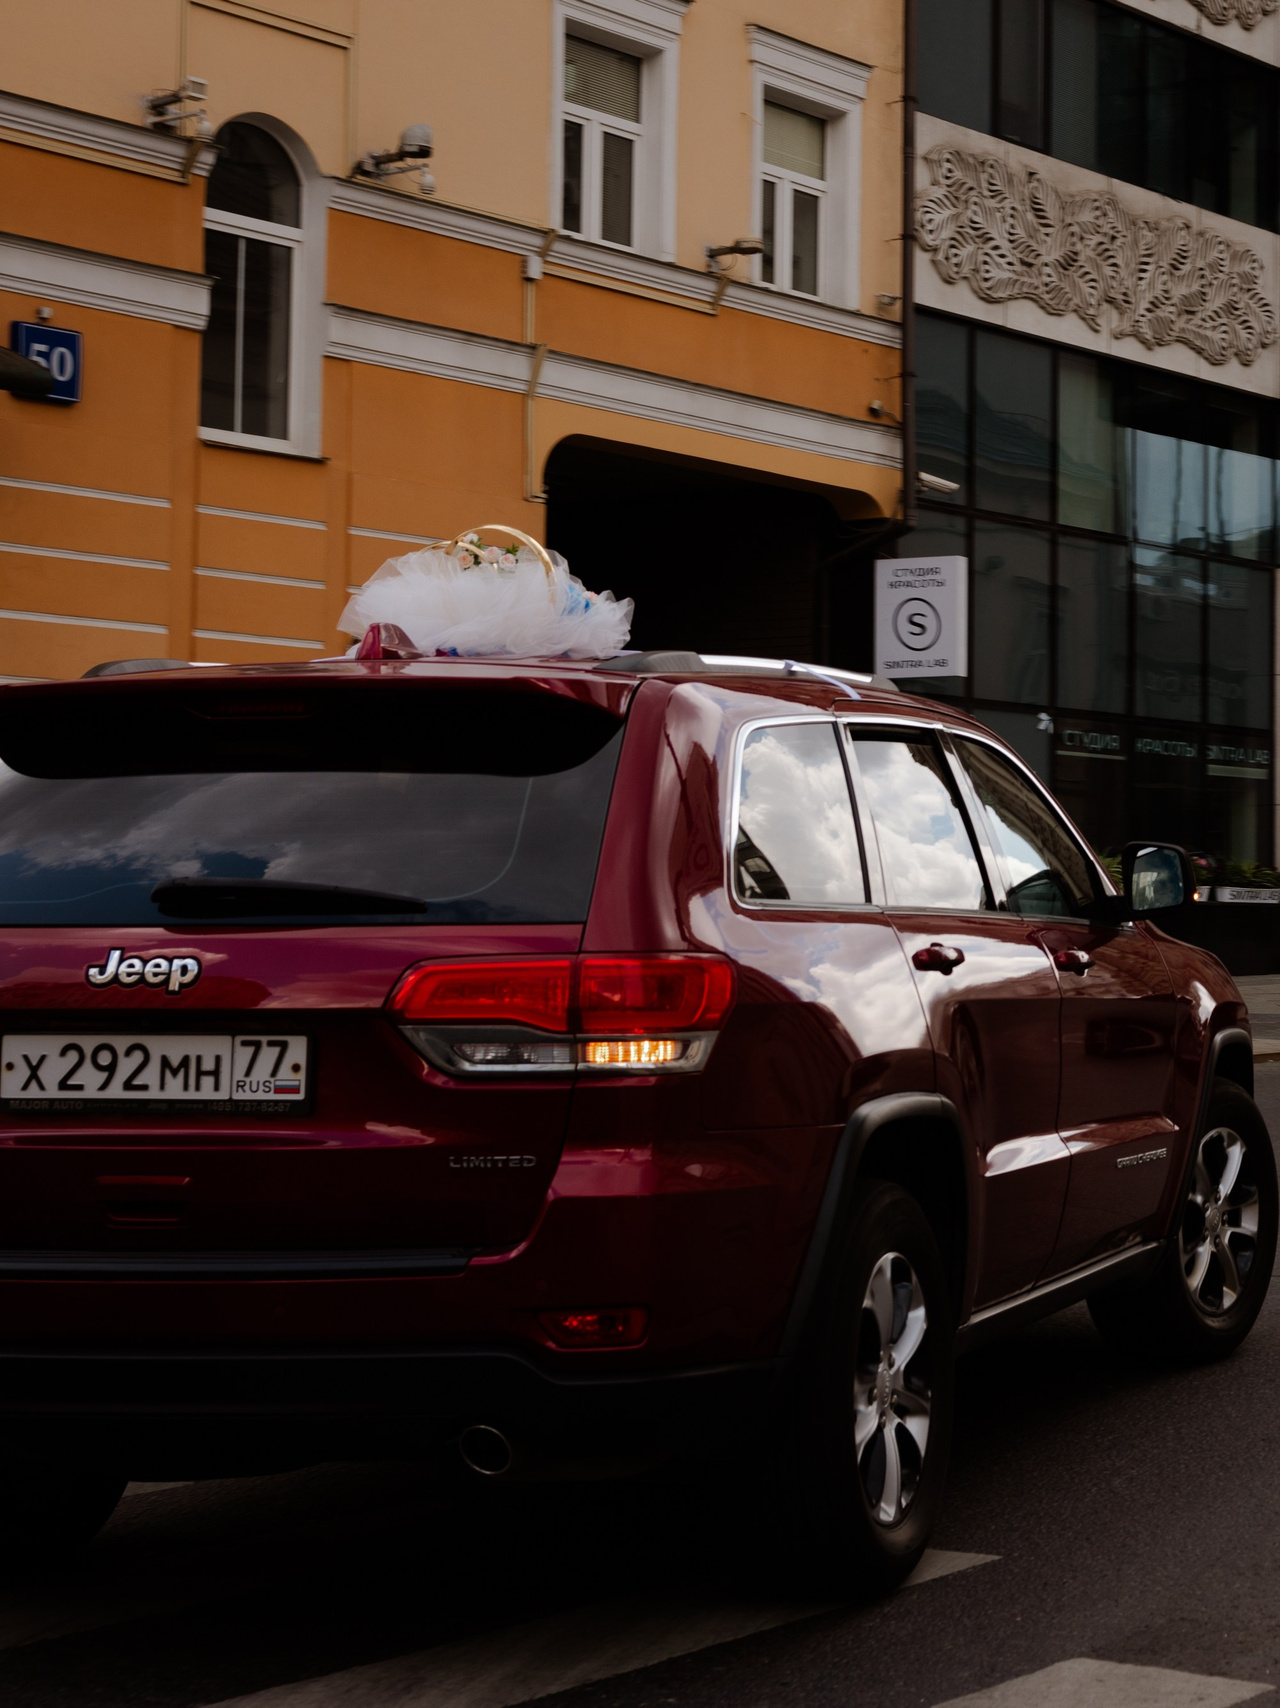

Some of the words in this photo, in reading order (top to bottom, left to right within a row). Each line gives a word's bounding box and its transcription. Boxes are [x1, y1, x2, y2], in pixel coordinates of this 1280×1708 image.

[28, 342, 75, 382] 50
[86, 948, 201, 994] Jeep
[240, 1039, 289, 1078] 77
[235, 1079, 272, 1094] RUS
[9, 1100, 50, 1111] MAJOR
[53, 1100, 84, 1111] AUTO
[449, 1155, 537, 1168] LIMITED
